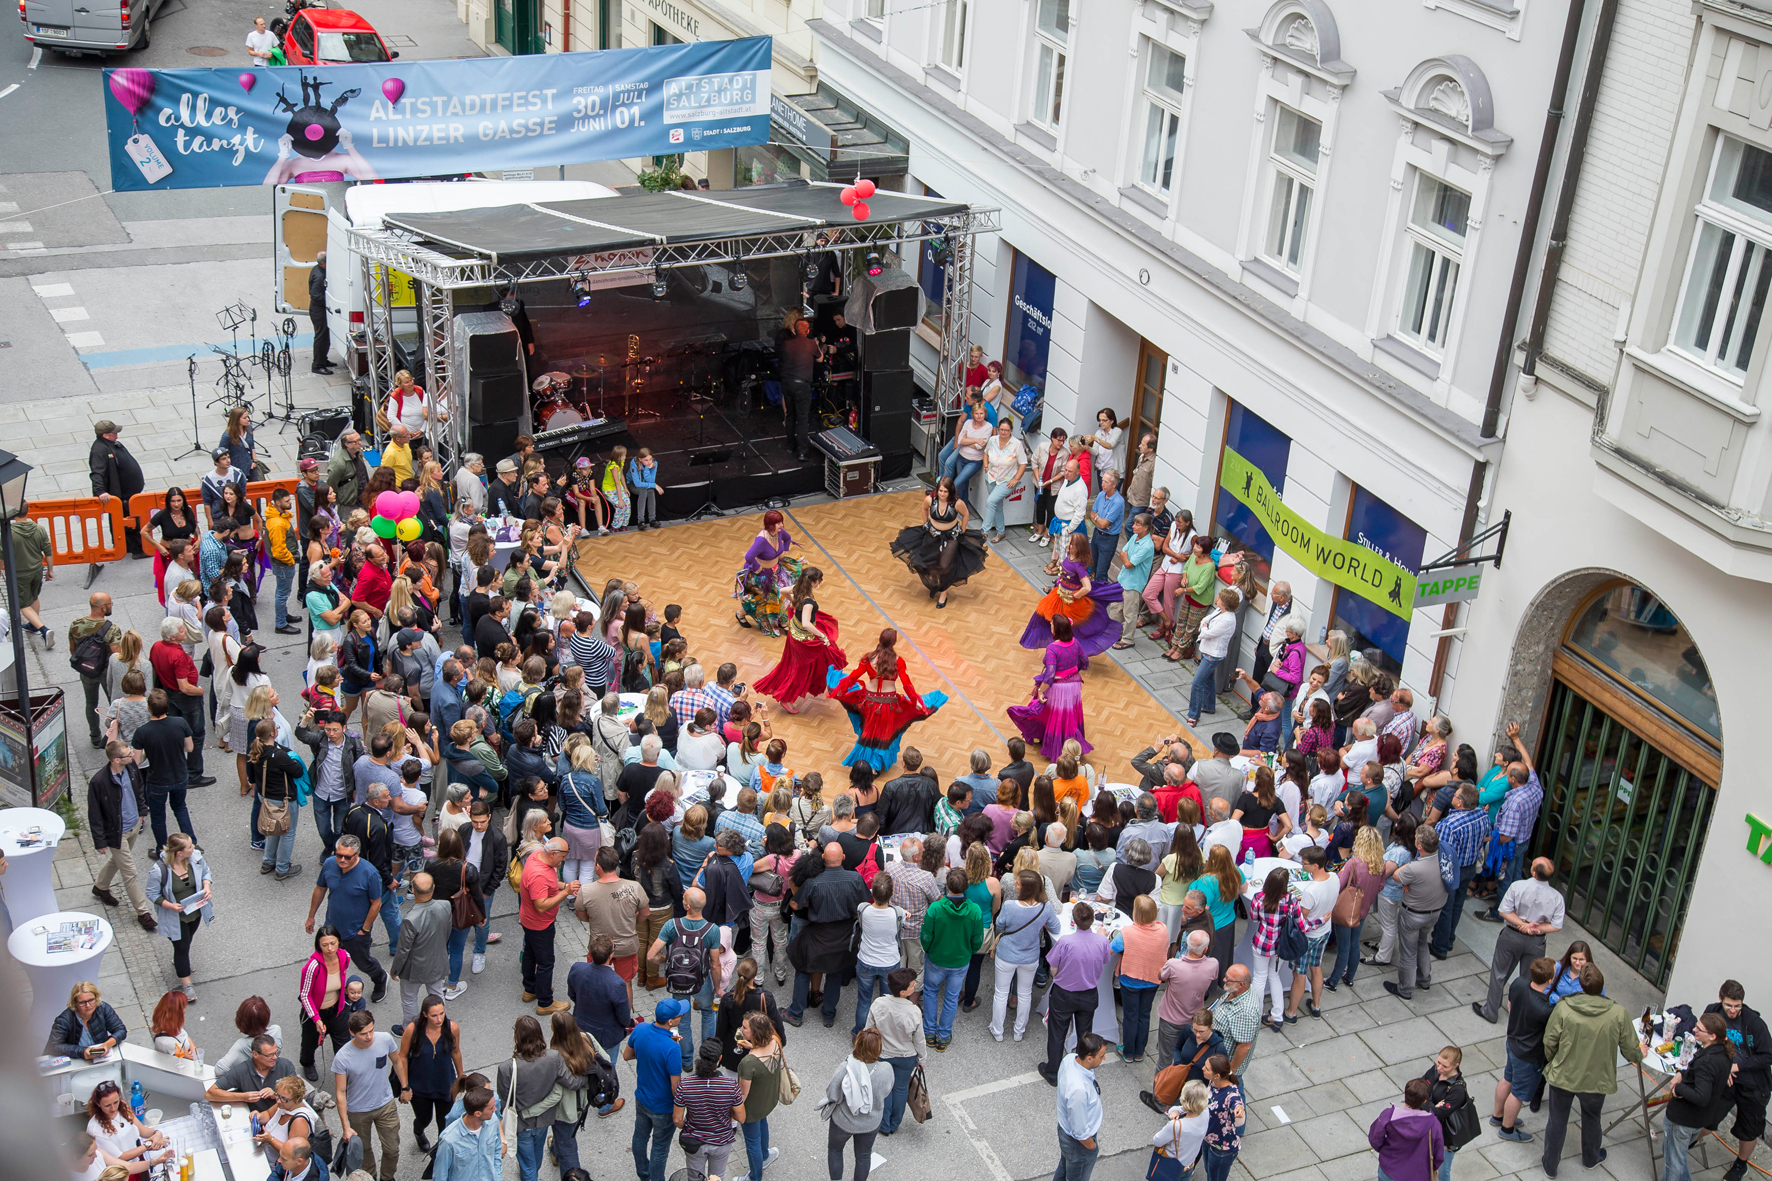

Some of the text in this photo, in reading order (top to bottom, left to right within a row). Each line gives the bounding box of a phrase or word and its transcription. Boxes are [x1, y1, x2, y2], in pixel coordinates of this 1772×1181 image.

[573, 82, 649, 94] FREITAG SAMSTAG
[670, 75, 753, 95] ALTSTADT
[369, 88, 557, 121] ALTSTADTFEST
[572, 95, 604, 118] 30.
[615, 90, 646, 105] JULI
[669, 90, 752, 108] SALZBURG
[158, 92, 245, 128] alles
[615, 105, 645, 128] 01.
[669, 106, 752, 119] www.salzburg-altstadt.at
[372, 116, 558, 148] LINZER GASSE
[570, 117, 605, 132] JUNI
[723, 126, 751, 134] SALZBURG
[174, 126, 265, 166] tanzt
[139, 157, 152, 167] 2
[144, 143, 165, 170] VOLUME
[562, 435, 579, 443] Roland
[1256, 485, 1383, 588] BALLROOM WORLD
[1384, 551, 1391, 562] &
[1418, 575, 1480, 597] TAPPE
